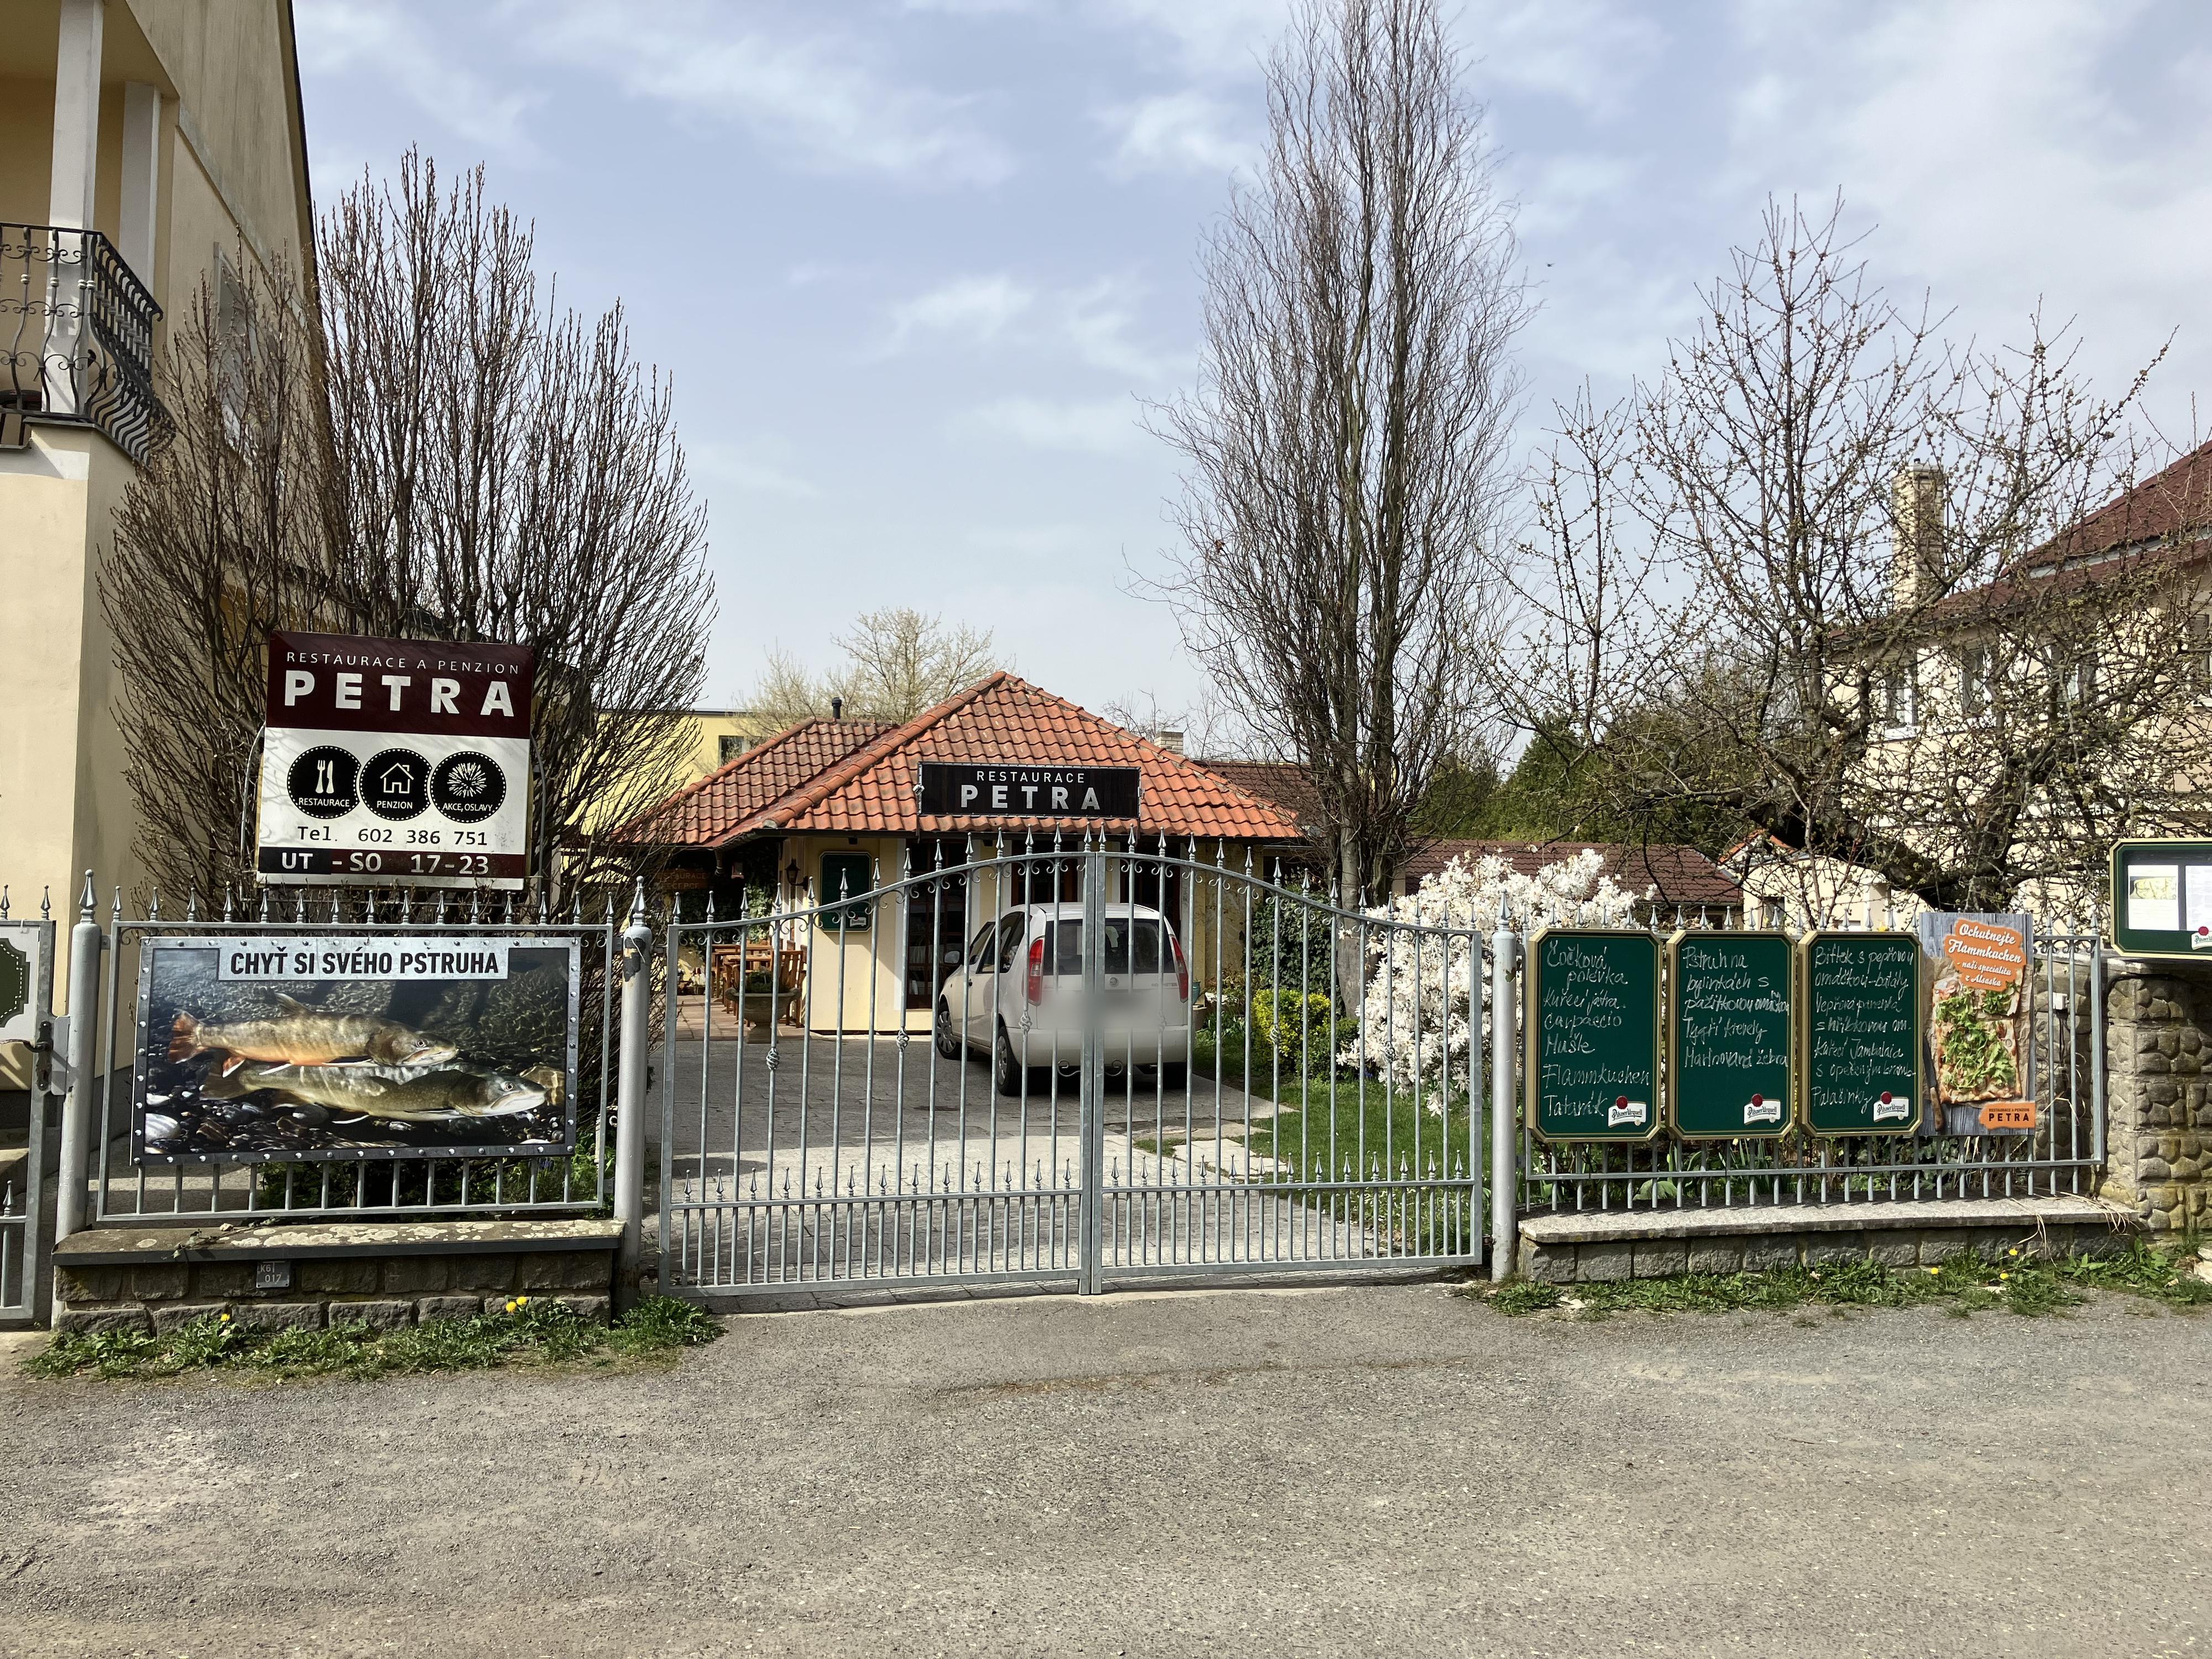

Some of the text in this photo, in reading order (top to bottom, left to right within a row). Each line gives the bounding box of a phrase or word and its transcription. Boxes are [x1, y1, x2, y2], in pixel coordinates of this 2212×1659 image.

[287, 652, 519, 674] RESTAURACE A PENZION
[285, 670, 515, 717] PETRA
[977, 770, 1084, 783] RESTAURACE
[299, 797, 350, 807] RESTAURACE
[377, 800, 413, 809] PENZION
[464, 803, 493, 812] OSLAVY
[961, 784, 1100, 810] PETRA
[297, 826, 487, 846] Tel. 602 386 751
[281, 852, 314, 870] UT
[349, 852, 382, 872] SO
[1959, 924, 2016, 946] Ochutnejte
[231, 946, 500, 974] CHYŤ SI SVÉHO PSTRUHA
[1547, 940, 1607, 969] Čočková
[1682, 946, 1749, 970] Pstruh na
[1815, 943, 1854, 968] Biftek
[1948, 938, 2022, 963] Flammkuchen
[1961, 960, 1978, 969] naši
[1566, 966, 1628, 990] polévka
[1687, 972, 1751, 999] bylinkách
[1971, 974, 2002, 987] Alsaska
[1543, 986, 1589, 1008] Kuřecí
[1682, 1016, 1768, 1046] Tygří krevety
[1545, 1032, 1595, 1056] Mušle
[1684, 1046, 1788, 1069] Marinovaná žebra
[1542, 1063, 1650, 1089] Flammkuchen
[1543, 1090, 1608, 1117] Tatarák
[1811, 1086, 1872, 1114] Palačinky
[1989, 1113, 2029, 1121] PETRA
